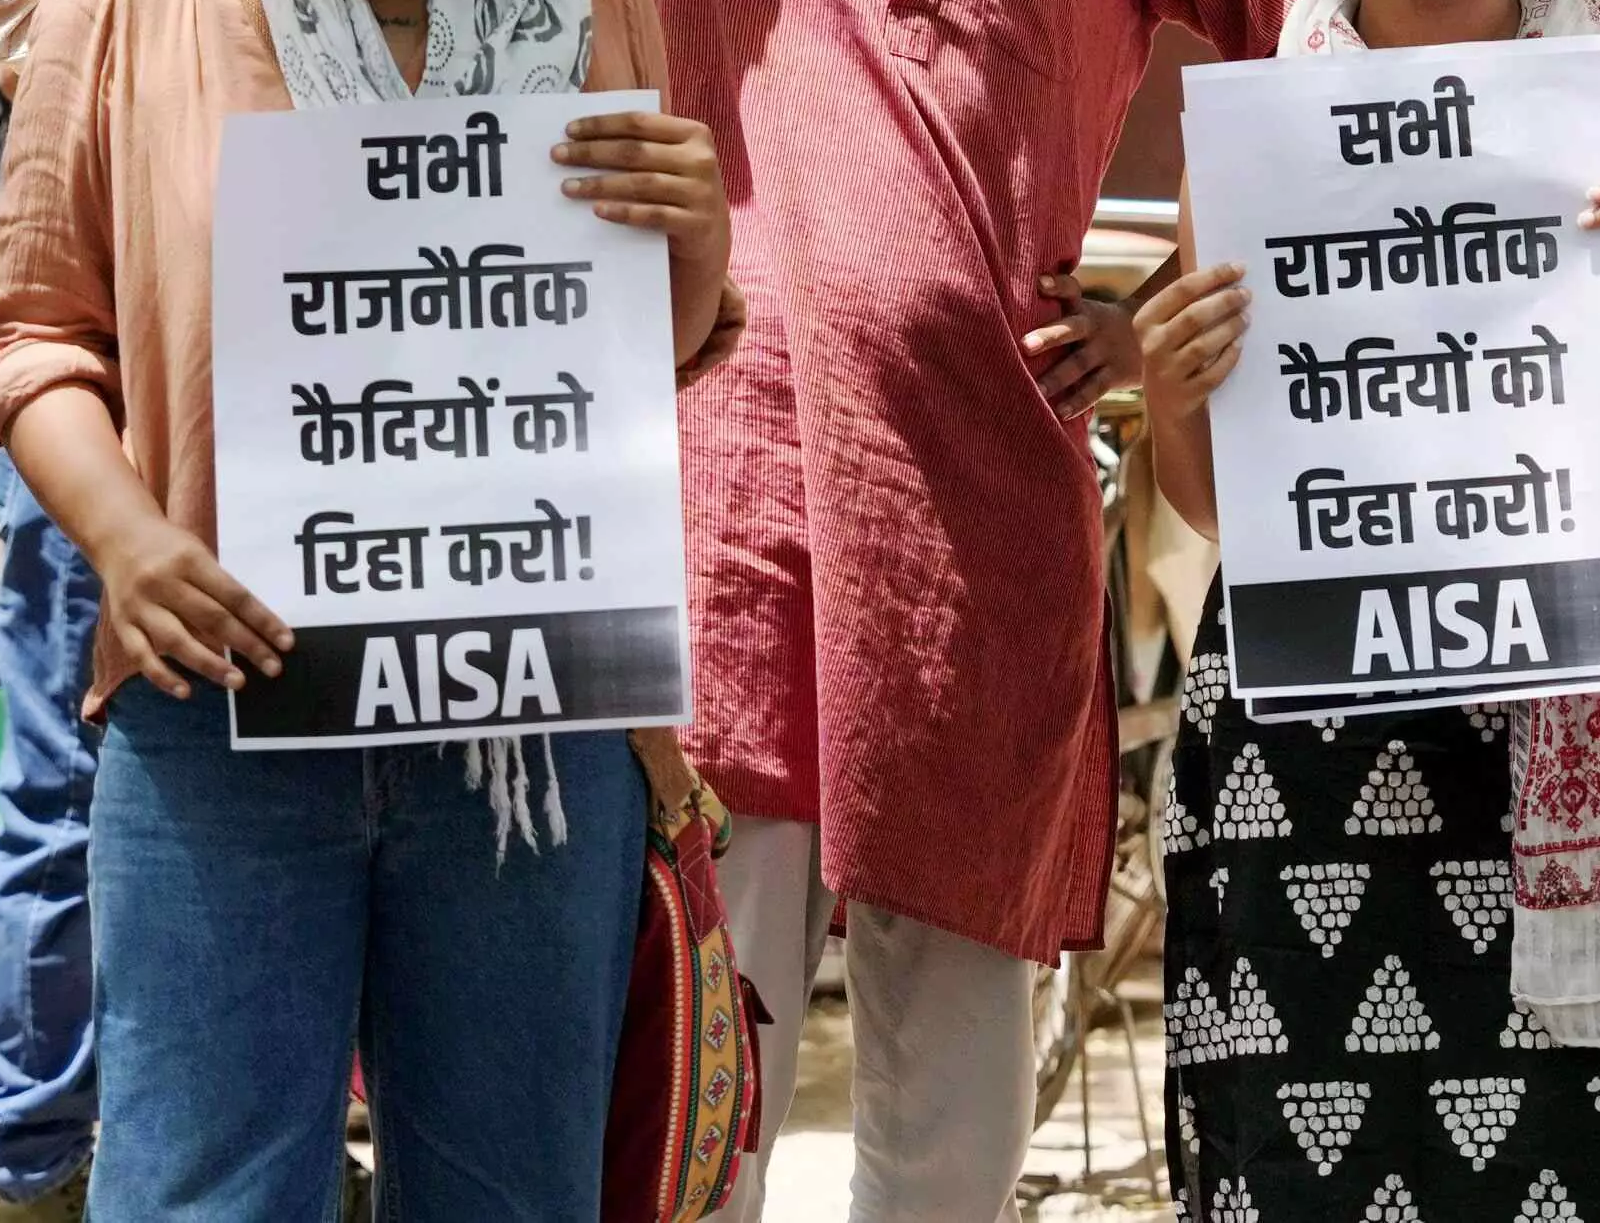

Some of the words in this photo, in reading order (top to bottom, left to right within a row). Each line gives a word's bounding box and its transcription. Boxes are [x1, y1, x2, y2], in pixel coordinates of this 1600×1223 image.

[361, 110, 508, 201] सभी
[1330, 74, 1476, 167] सभी
[282, 244, 592, 336] राजनैतिक
[1264, 201, 1562, 298] राजनैतिक
[291, 376, 501, 466] कैदियों
[505, 371, 595, 454] को
[1278, 331, 1482, 424] कैदियों
[1483, 323, 1569, 408] को
[294, 510, 429, 596] रिहा
[440, 498, 596, 587] करो!
[1288, 467, 1416, 552] रिहा
[1426, 452, 1577, 539] करो!
[1351, 576, 1550, 675] AISA
[353, 626, 562, 728] AISA
